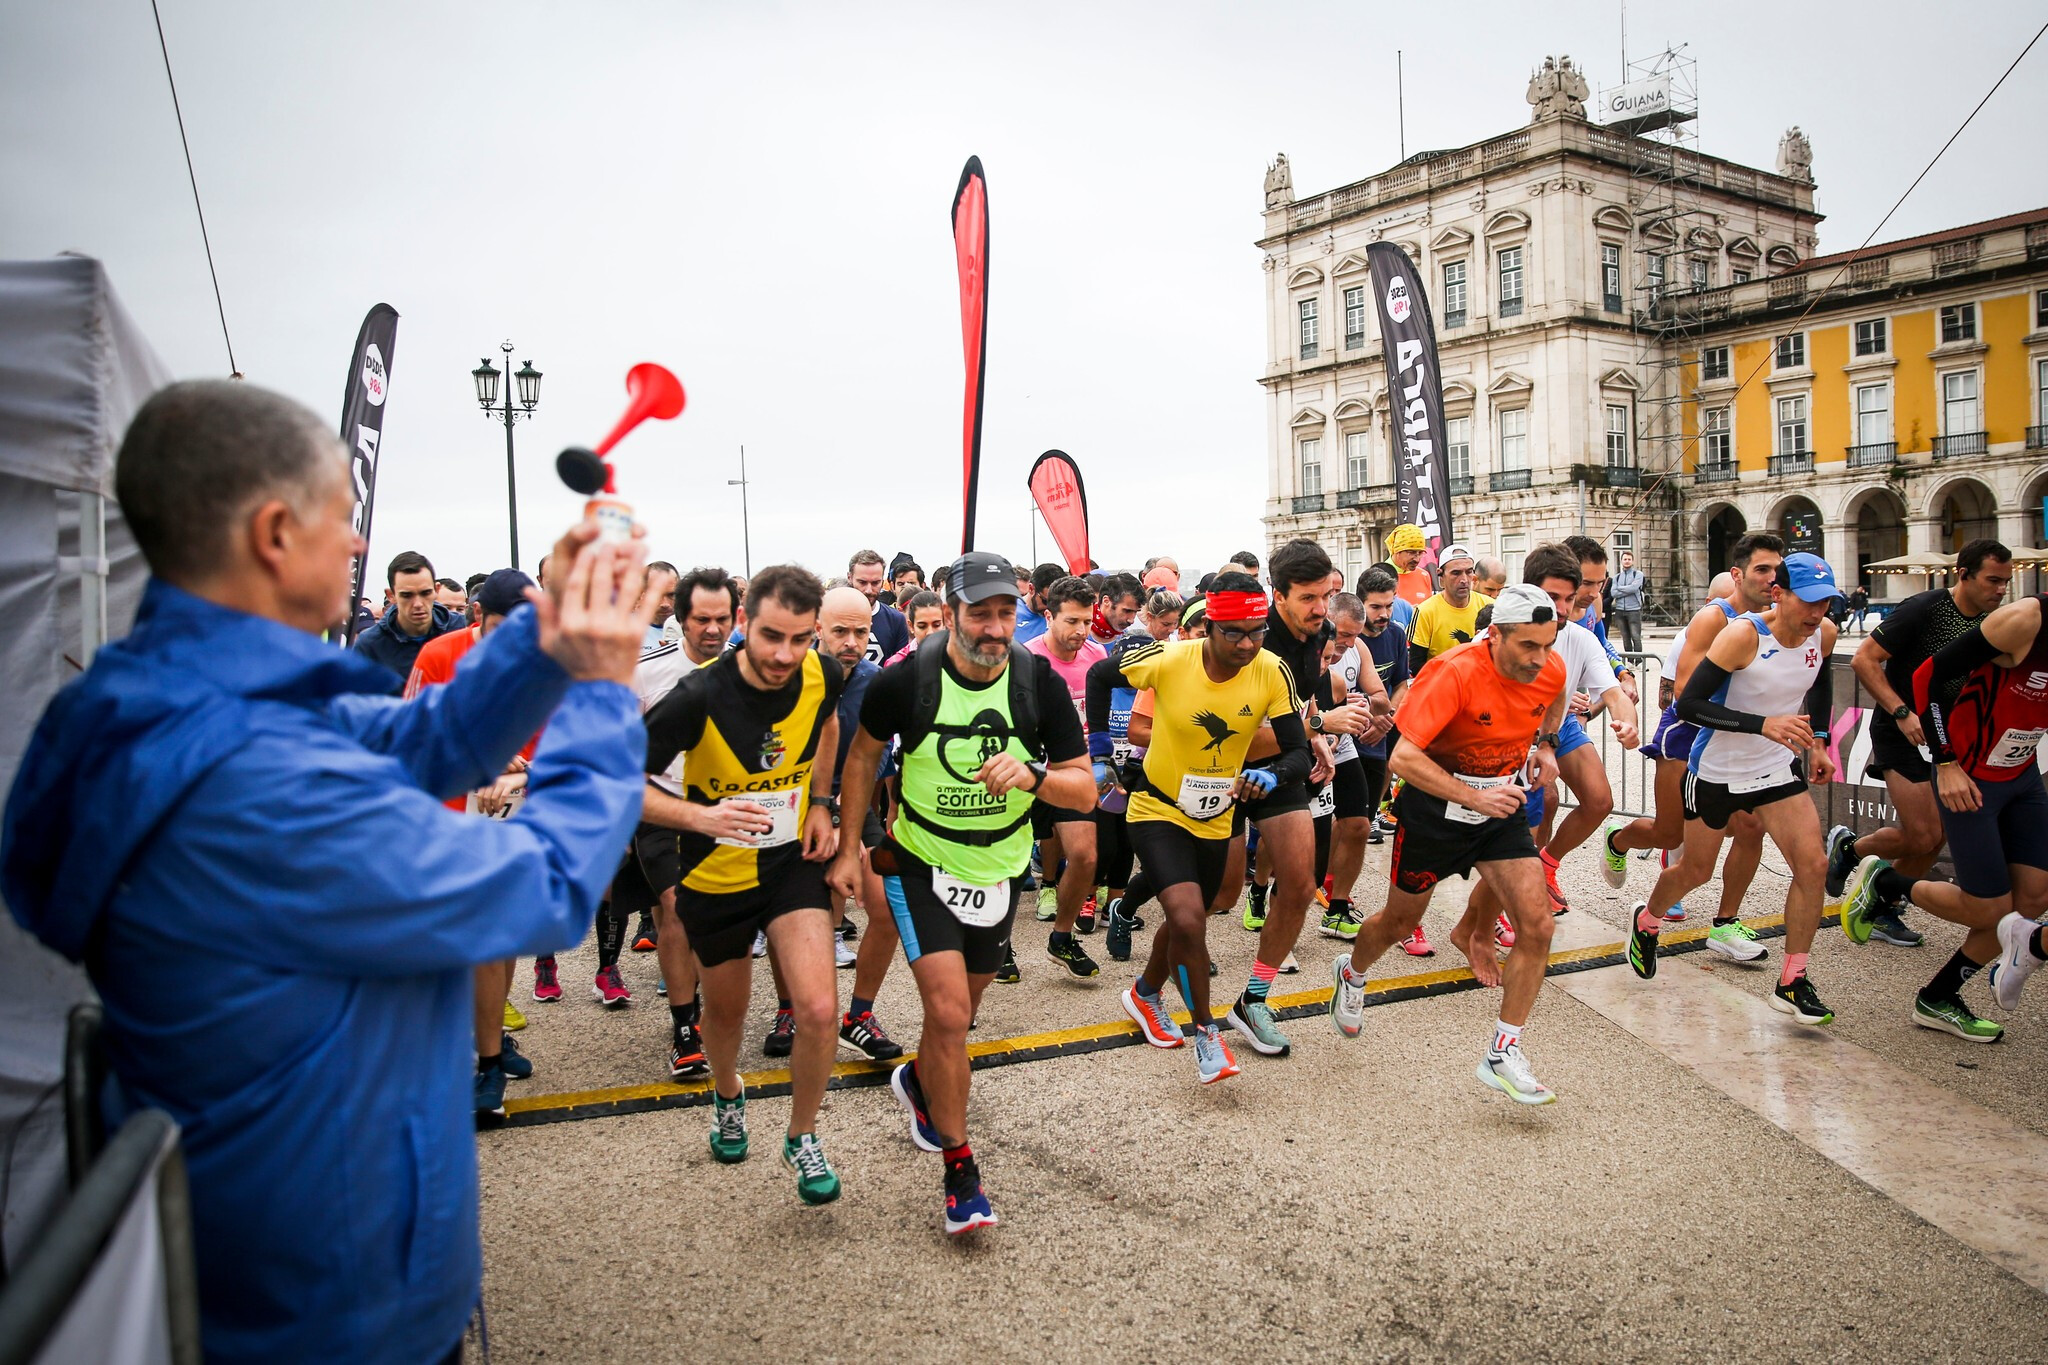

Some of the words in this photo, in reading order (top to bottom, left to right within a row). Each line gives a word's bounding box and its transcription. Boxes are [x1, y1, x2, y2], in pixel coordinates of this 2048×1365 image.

[1611, 89, 1664, 112] GUIANA
[2015, 683, 2048, 698] SEAT
[1930, 702, 1947, 745] COMPRESSION
[1114, 749, 1132, 760] 57
[1198, 796, 1220, 810] 19
[1318, 792, 1332, 808] 56
[938, 808, 959, 816] PORQUE
[946, 886, 986, 909] 270
